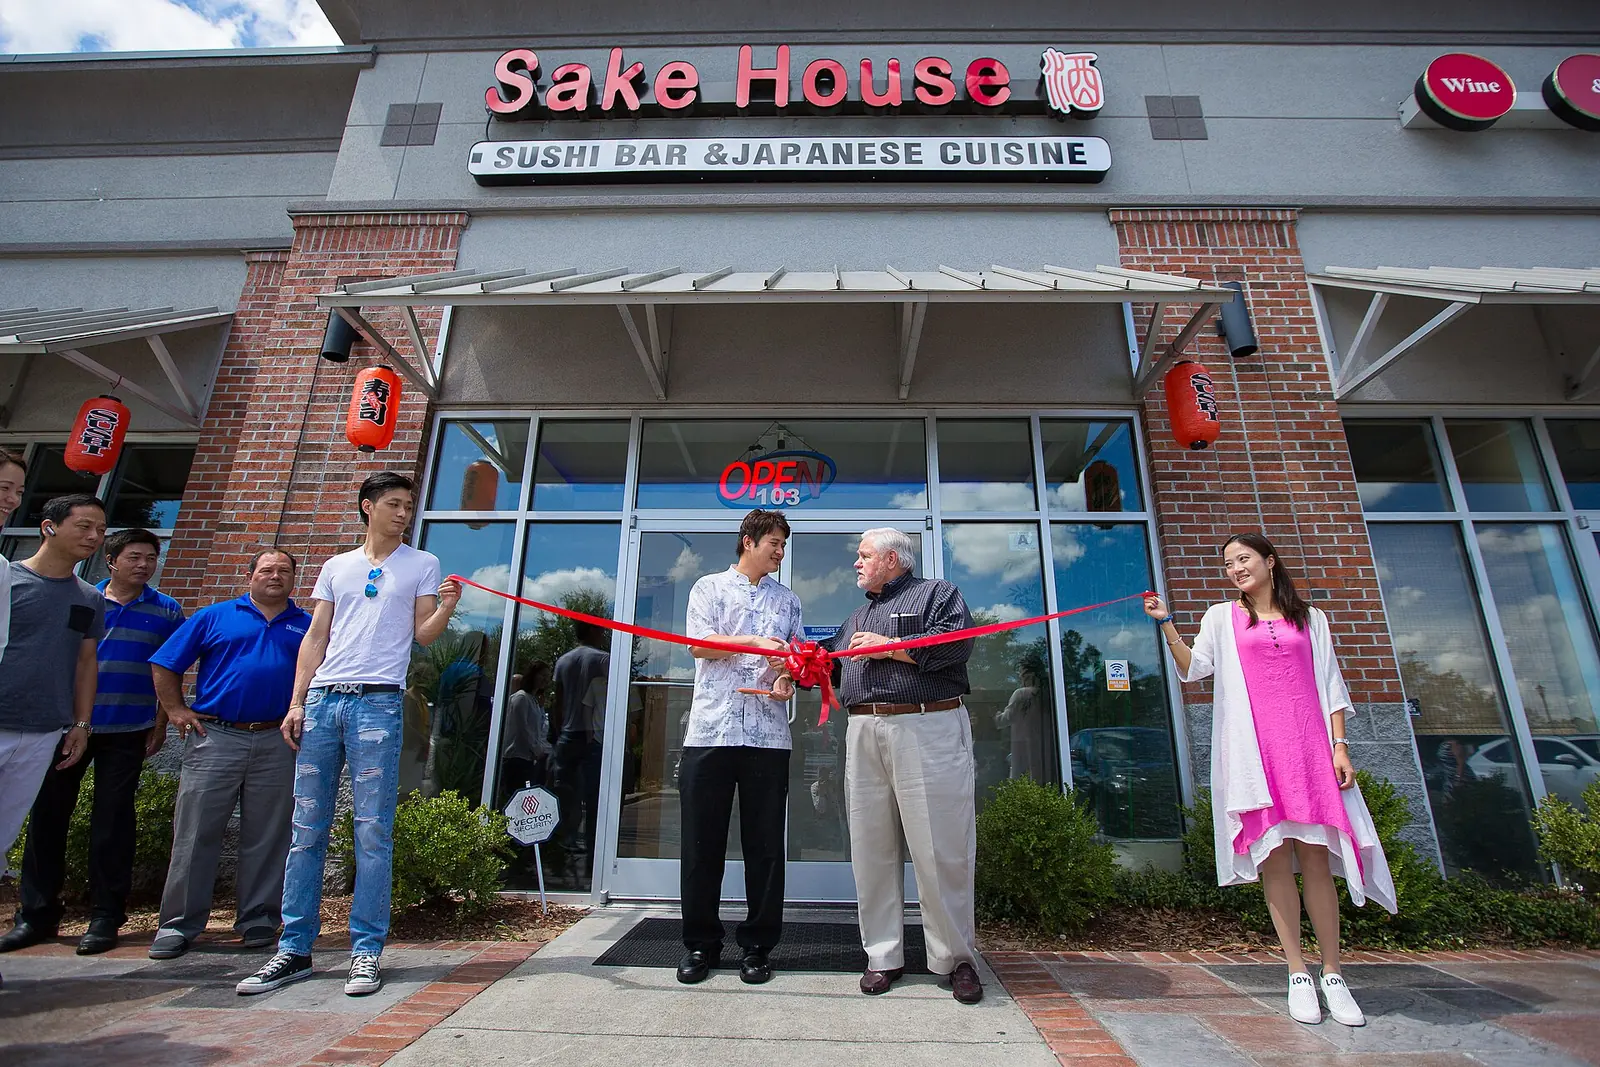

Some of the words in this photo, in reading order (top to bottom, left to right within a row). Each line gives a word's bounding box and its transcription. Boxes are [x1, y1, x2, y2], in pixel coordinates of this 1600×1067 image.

[485, 46, 700, 114] Sake
[735, 44, 1012, 108] House
[1440, 78, 1502, 94] Wine
[493, 145, 600, 169] SUSHI
[614, 143, 688, 167] BAR
[939, 142, 1088, 165] CUISINE
[719, 460, 826, 500] OPEN
[756, 487, 801, 506] 103
[513, 813, 552, 827] VECTOR
[514, 820, 553, 833] SECURITY
[1292, 976, 1313, 987] LOVE
